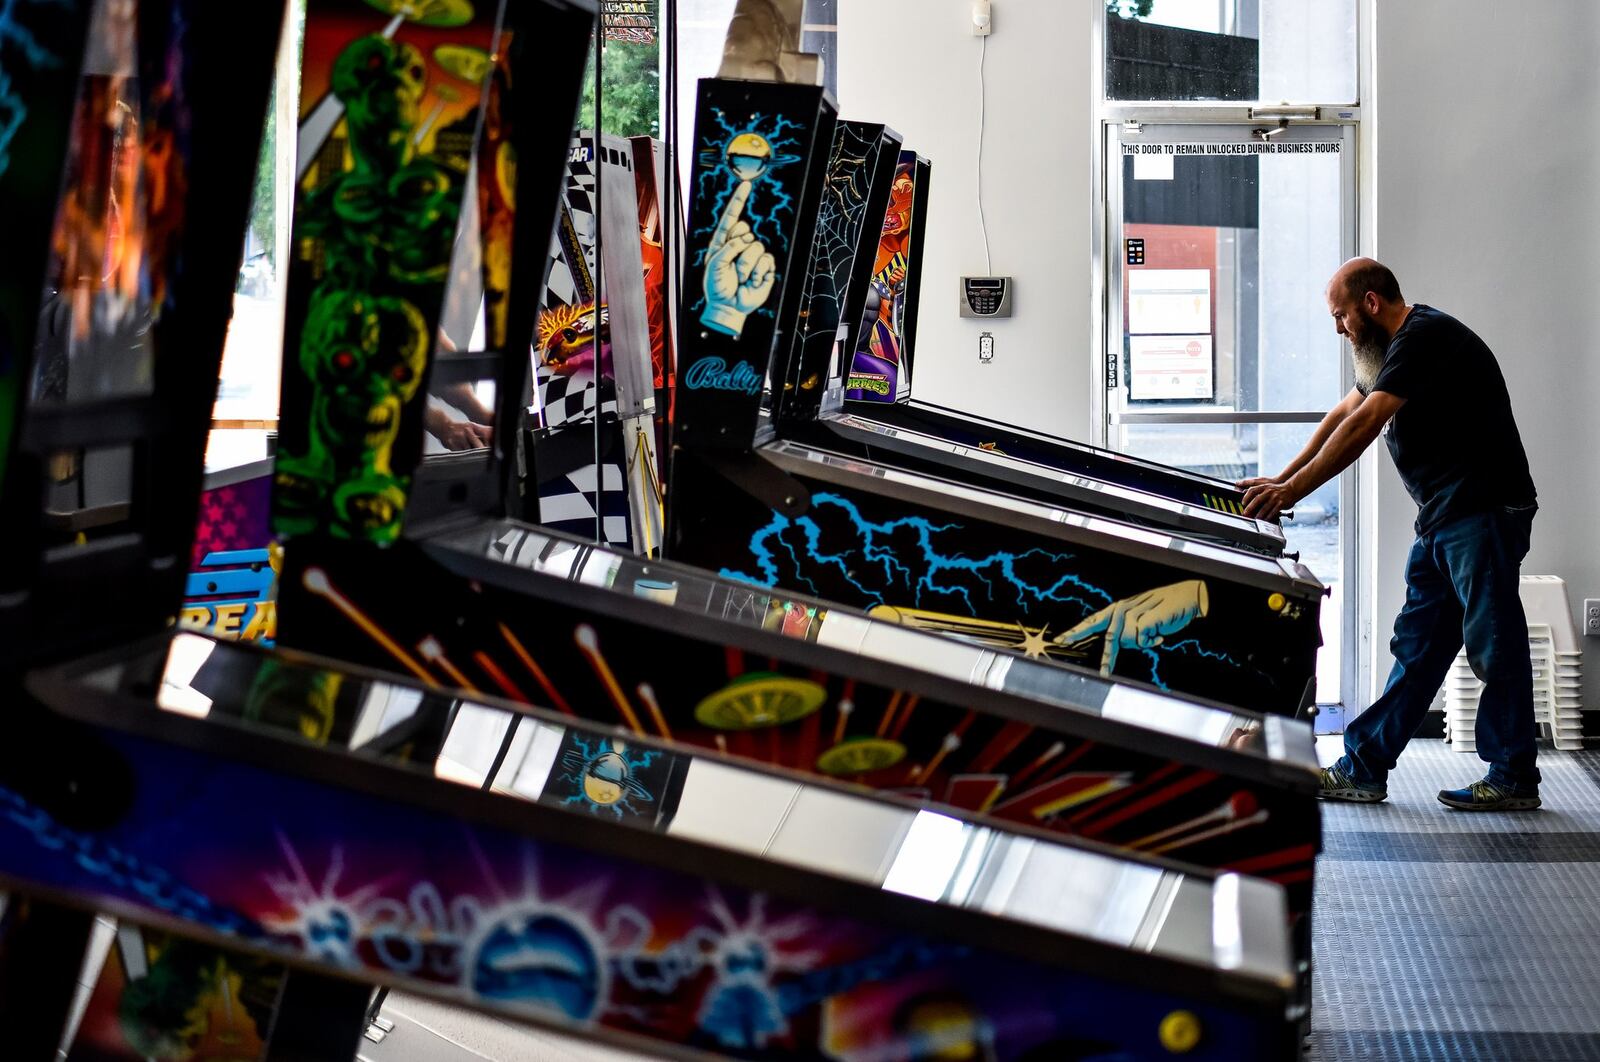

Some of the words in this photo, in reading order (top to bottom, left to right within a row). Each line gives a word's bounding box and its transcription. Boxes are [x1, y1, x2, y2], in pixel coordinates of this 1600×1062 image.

[1122, 144, 1140, 154] THIS
[1142, 144, 1162, 154] DOOR
[1164, 144, 1174, 154] TO
[1176, 144, 1205, 154] REMAIN
[1206, 144, 1246, 154] UNLOCKED
[1247, 143, 1275, 153] DURING
[1277, 143, 1313, 153] BUSINESS
[1315, 143, 1340, 153] HOURS
[685, 356, 762, 395] Bally
[1108, 355, 1116, 387] PUSH
